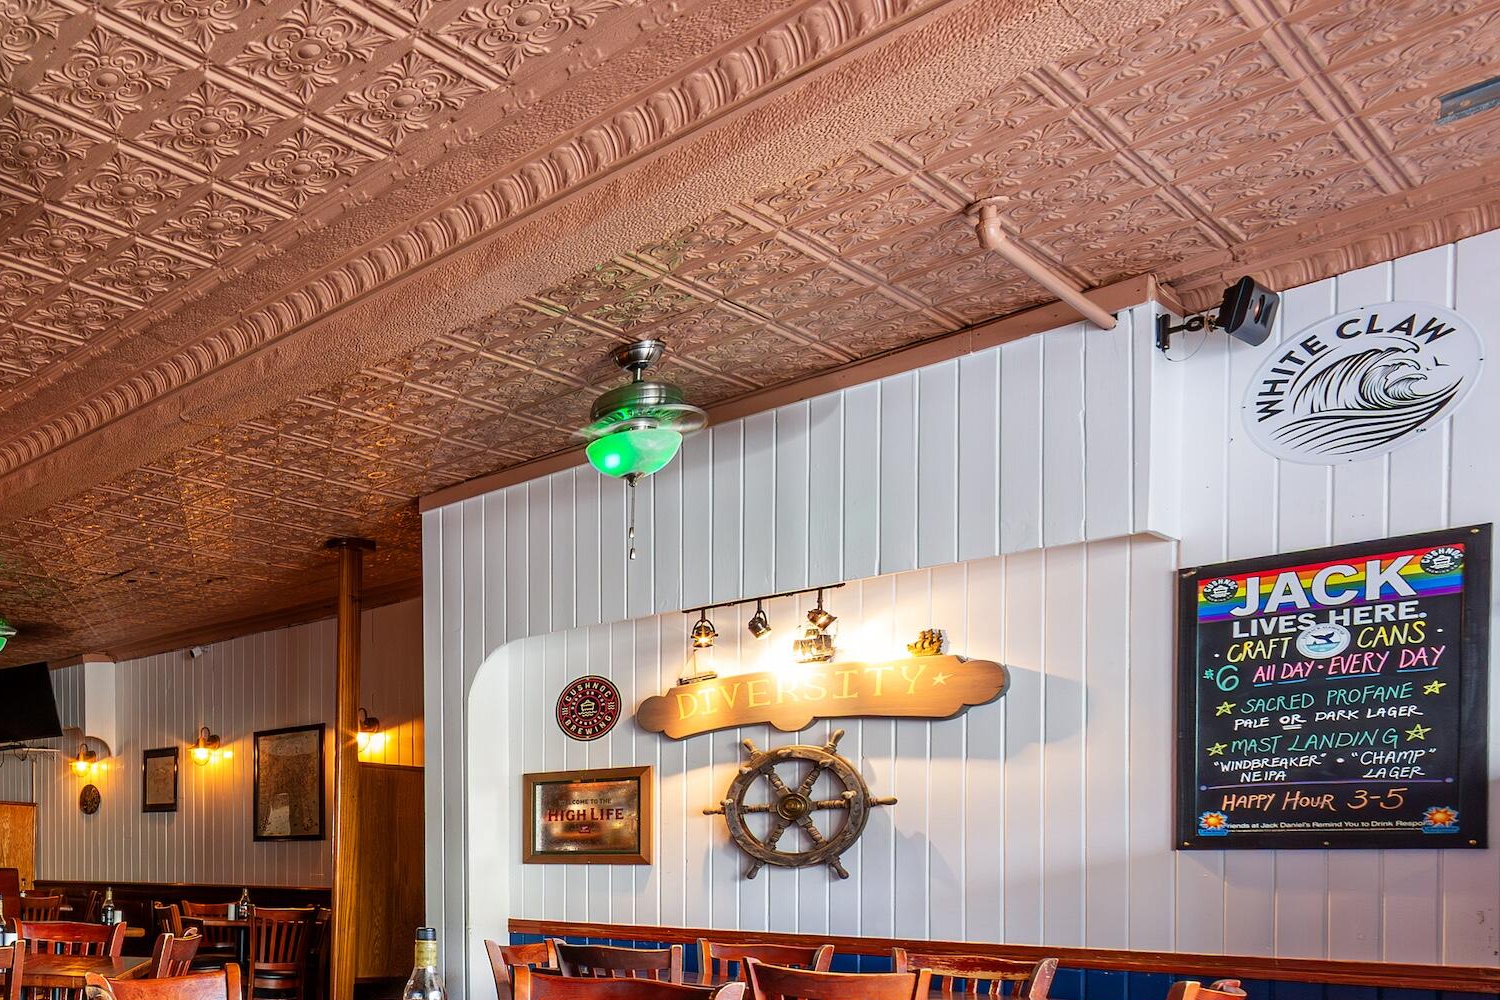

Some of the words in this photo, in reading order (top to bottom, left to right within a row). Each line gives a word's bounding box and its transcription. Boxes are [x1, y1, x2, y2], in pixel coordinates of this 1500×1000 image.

[1255, 334, 1329, 422] WHITE
[1336, 313, 1457, 345] CLAW
[1229, 554, 1417, 617] JACK
[1232, 612, 1316, 639] LIVES
[1328, 600, 1428, 627] HERE.
[1226, 636, 1293, 663] CRAFT
[1357, 621, 1427, 649] CANS
[1281, 660, 1316, 679] DAY
[1327, 651, 1391, 676] EVERY
[1399, 645, 1446, 668] DAY
[565, 682, 612, 702] CUSHNOC
[675, 664, 927, 721] DIVERSITY
[1240, 693, 1315, 714] SACRED
[1326, 682, 1414, 706] PROFANE
[564, 715, 612, 735] BREWING
[1234, 716, 1270, 730] PALE
[1279, 713, 1307, 725] OR
[1315, 709, 1359, 722] DARK
[1366, 704, 1424, 719] LAGER
[1231, 735, 1284, 754] MAST
[1288, 728, 1399, 751] LANDING
[1240, 770, 1287, 783] NEIPA
[1362, 765, 1426, 779] LAGER
[1221, 791, 1276, 812] HAPPY
[1282, 790, 1337, 812] HOUR
[1346, 787, 1409, 811] 3-5
[548, 808, 587, 822] HIGH
[590, 807, 624, 820] LIFE
[1344, 820, 1360, 828] You
